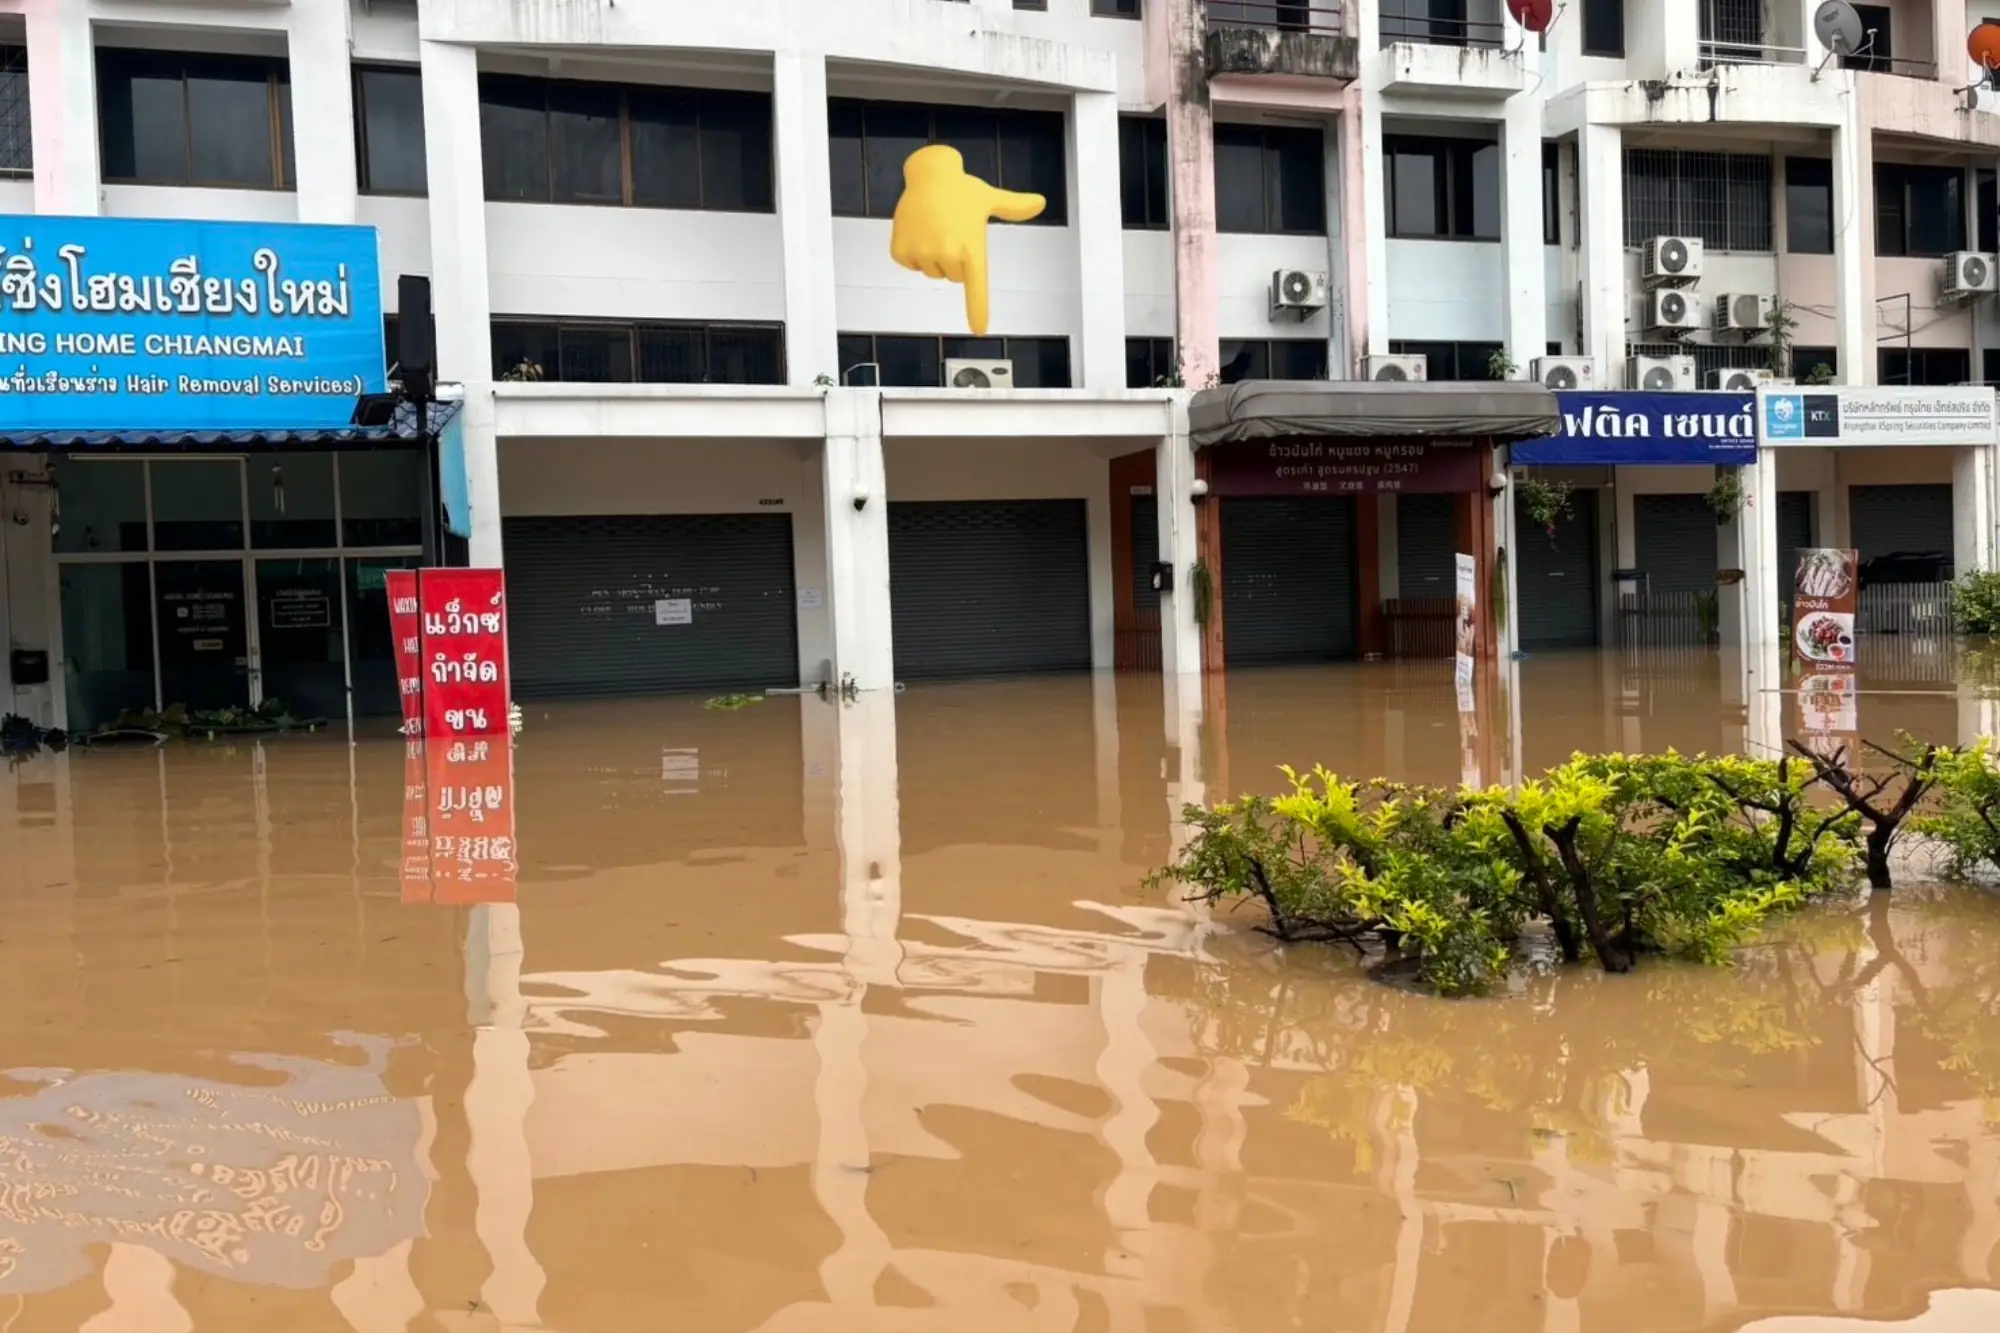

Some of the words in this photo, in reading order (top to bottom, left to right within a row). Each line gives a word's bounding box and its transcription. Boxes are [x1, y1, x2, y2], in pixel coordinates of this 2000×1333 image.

[56, 333, 136, 355] HOME
[144, 334, 305, 357] CHIANGMAI
[127, 373, 169, 394] Hair
[179, 375, 260, 394] Removal
[268, 374, 363, 396] Services)
[1560, 405, 1651, 438] ฟติค
[1811, 410, 1831, 421] KTX
[425, 591, 501, 635] แว็กซ์
[431, 652, 498, 683] กำจัด
[445, 707, 488, 730] ขน
